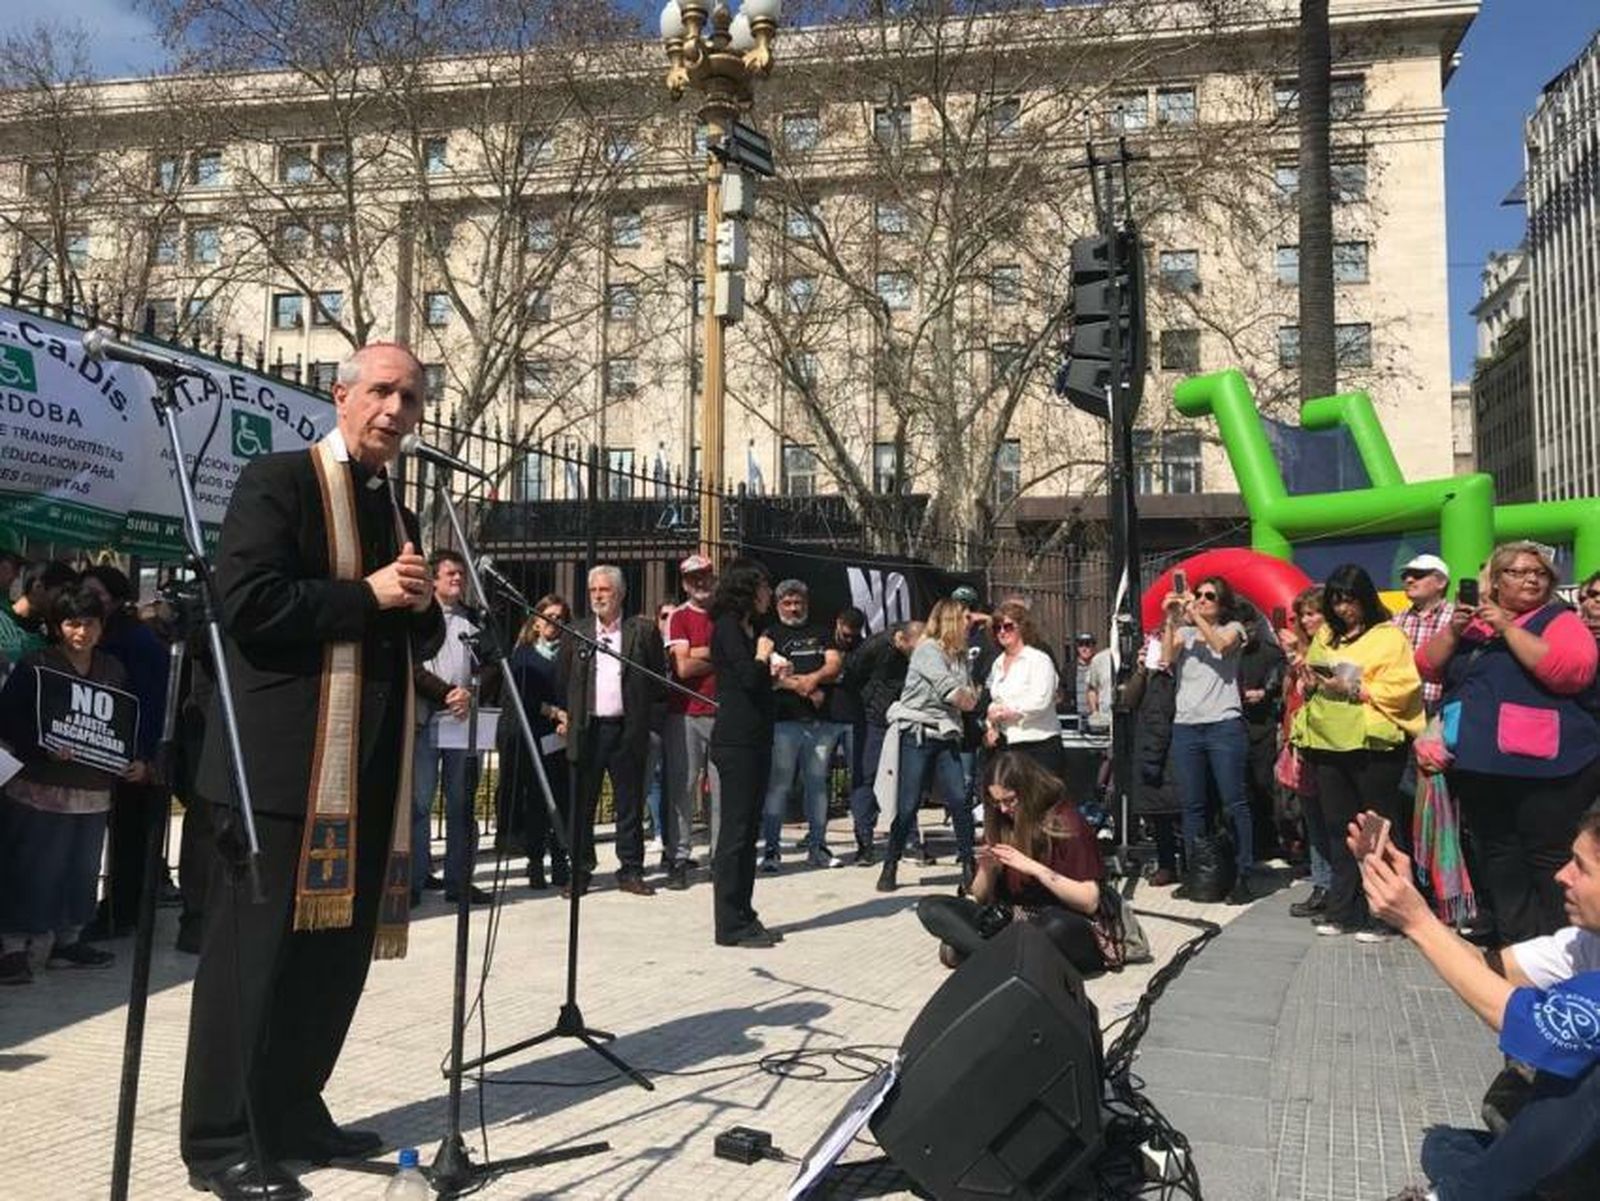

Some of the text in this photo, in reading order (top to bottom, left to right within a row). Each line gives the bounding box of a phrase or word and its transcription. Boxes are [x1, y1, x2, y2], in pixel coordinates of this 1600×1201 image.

[0, 321, 128, 422] .Ca.Dis.
[13, 426, 124, 462] TRANSPORTISTAS
[80, 461, 115, 480] PARA
[847, 566, 910, 638] NO
[71, 682, 114, 721] NO
[52, 719, 125, 754] DISCAPACIDAD
[73, 713, 108, 735] AJUSTE
